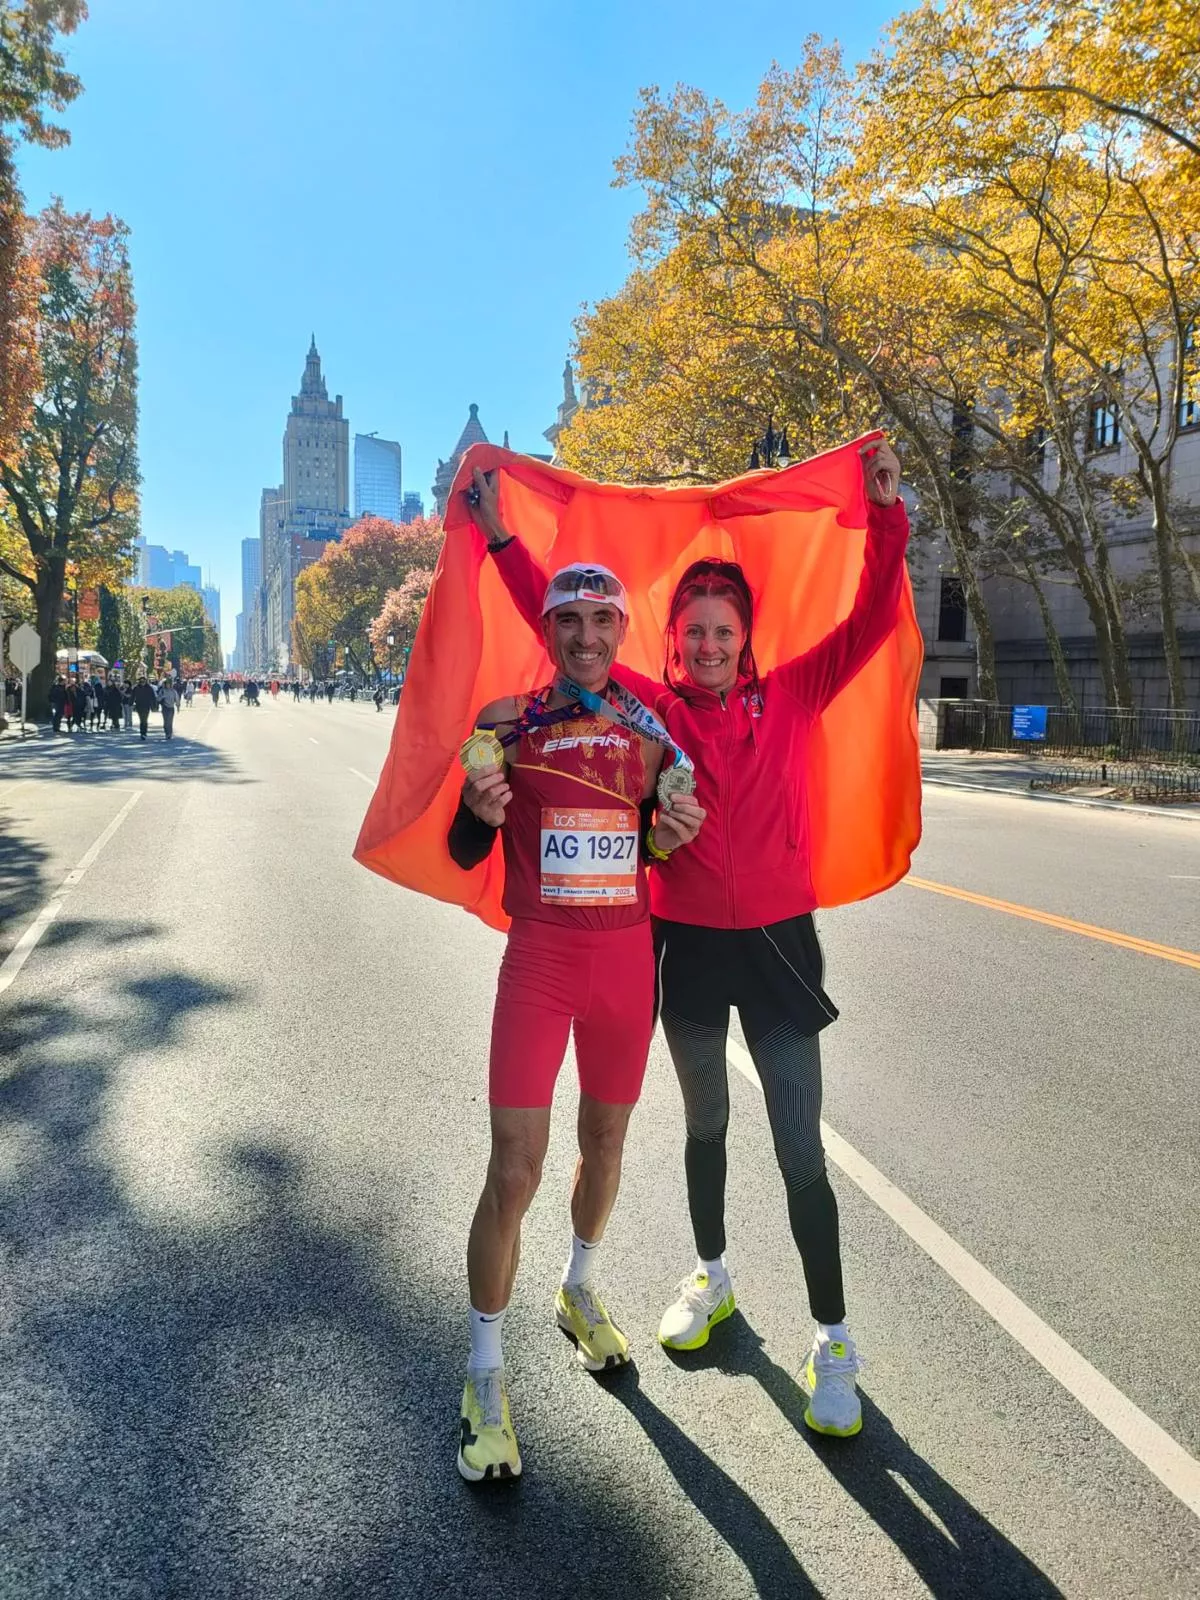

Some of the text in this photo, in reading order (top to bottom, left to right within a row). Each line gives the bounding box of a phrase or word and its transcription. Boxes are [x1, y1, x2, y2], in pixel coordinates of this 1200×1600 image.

[542, 734, 630, 753] ESPAÑA
[553, 812, 576, 827] tcs
[544, 834, 635, 860] AG 1927
